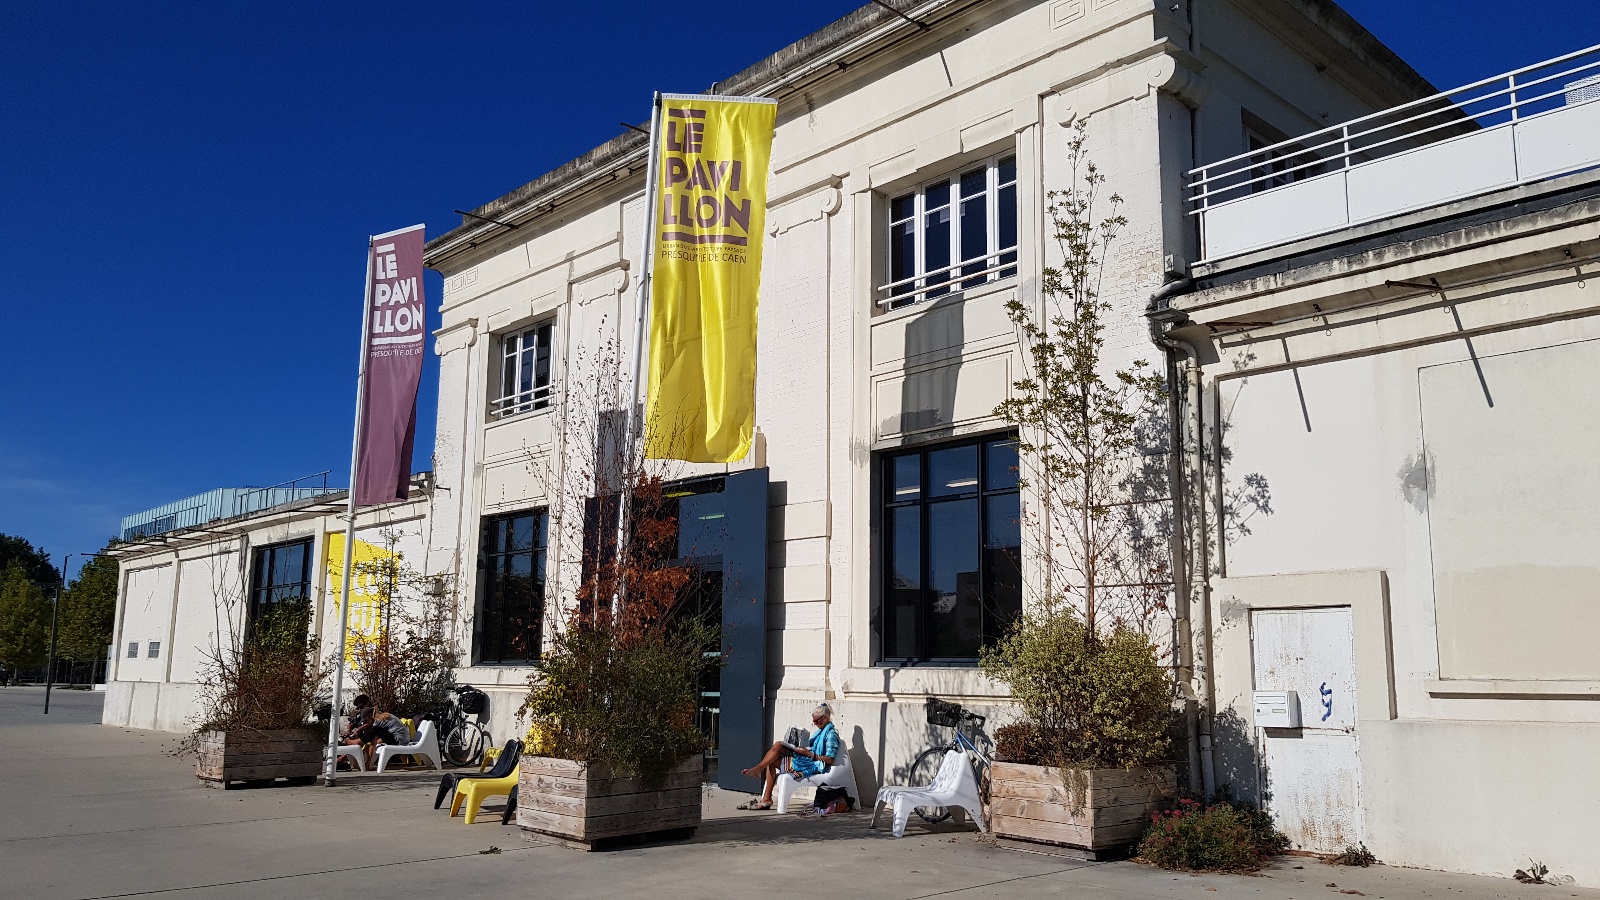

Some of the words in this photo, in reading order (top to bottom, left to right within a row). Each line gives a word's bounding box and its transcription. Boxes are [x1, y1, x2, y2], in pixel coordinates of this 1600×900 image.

[667, 121, 704, 154] LE
[664, 157, 742, 192] PAVI
[662, 193, 752, 235] LLON
[376, 253, 398, 280] LE
[708, 253, 719, 262] DE
[722, 253, 747, 264] CAEN
[374, 277, 418, 307] PAVI
[372, 303, 423, 334] LLON
